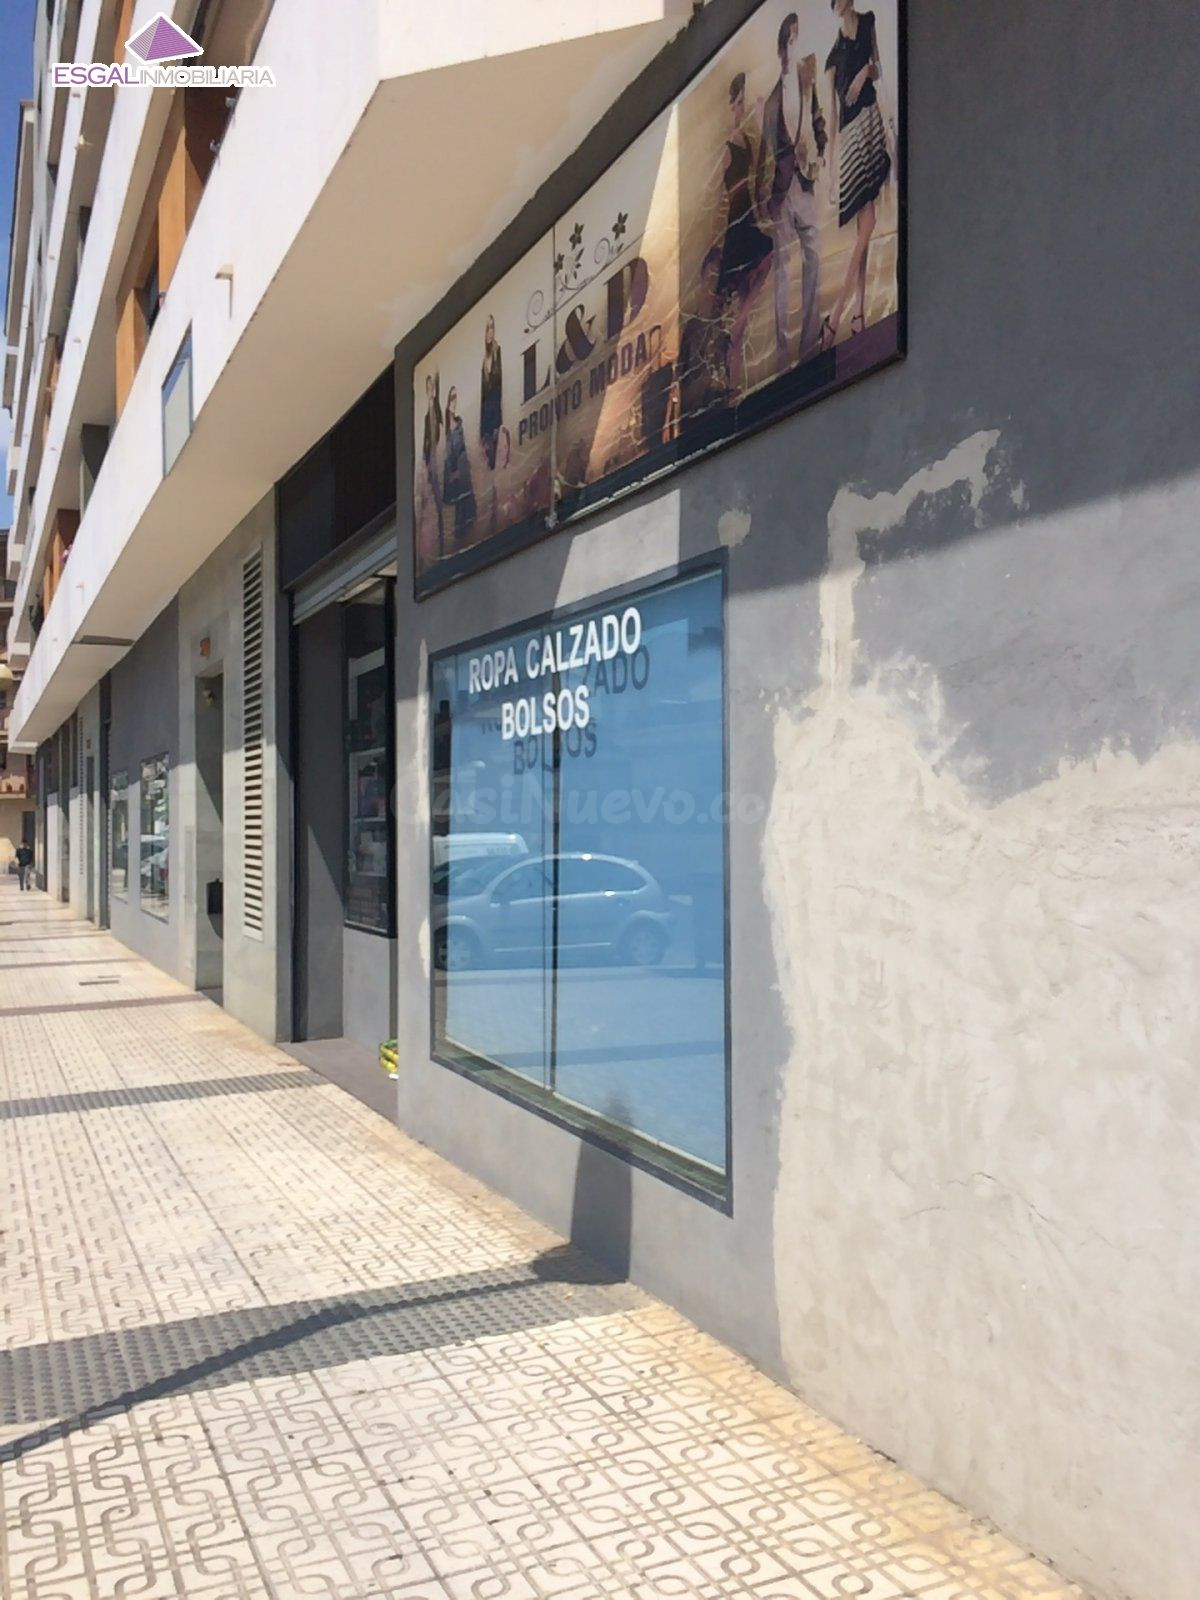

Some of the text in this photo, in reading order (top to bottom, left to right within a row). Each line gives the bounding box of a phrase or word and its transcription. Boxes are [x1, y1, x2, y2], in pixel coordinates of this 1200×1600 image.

[518, 331, 649, 446] PRONTO MODA
[468, 646, 519, 694] ROPA
[525, 606, 642, 679] CALZADO
[501, 684, 590, 740] BOLSOS
